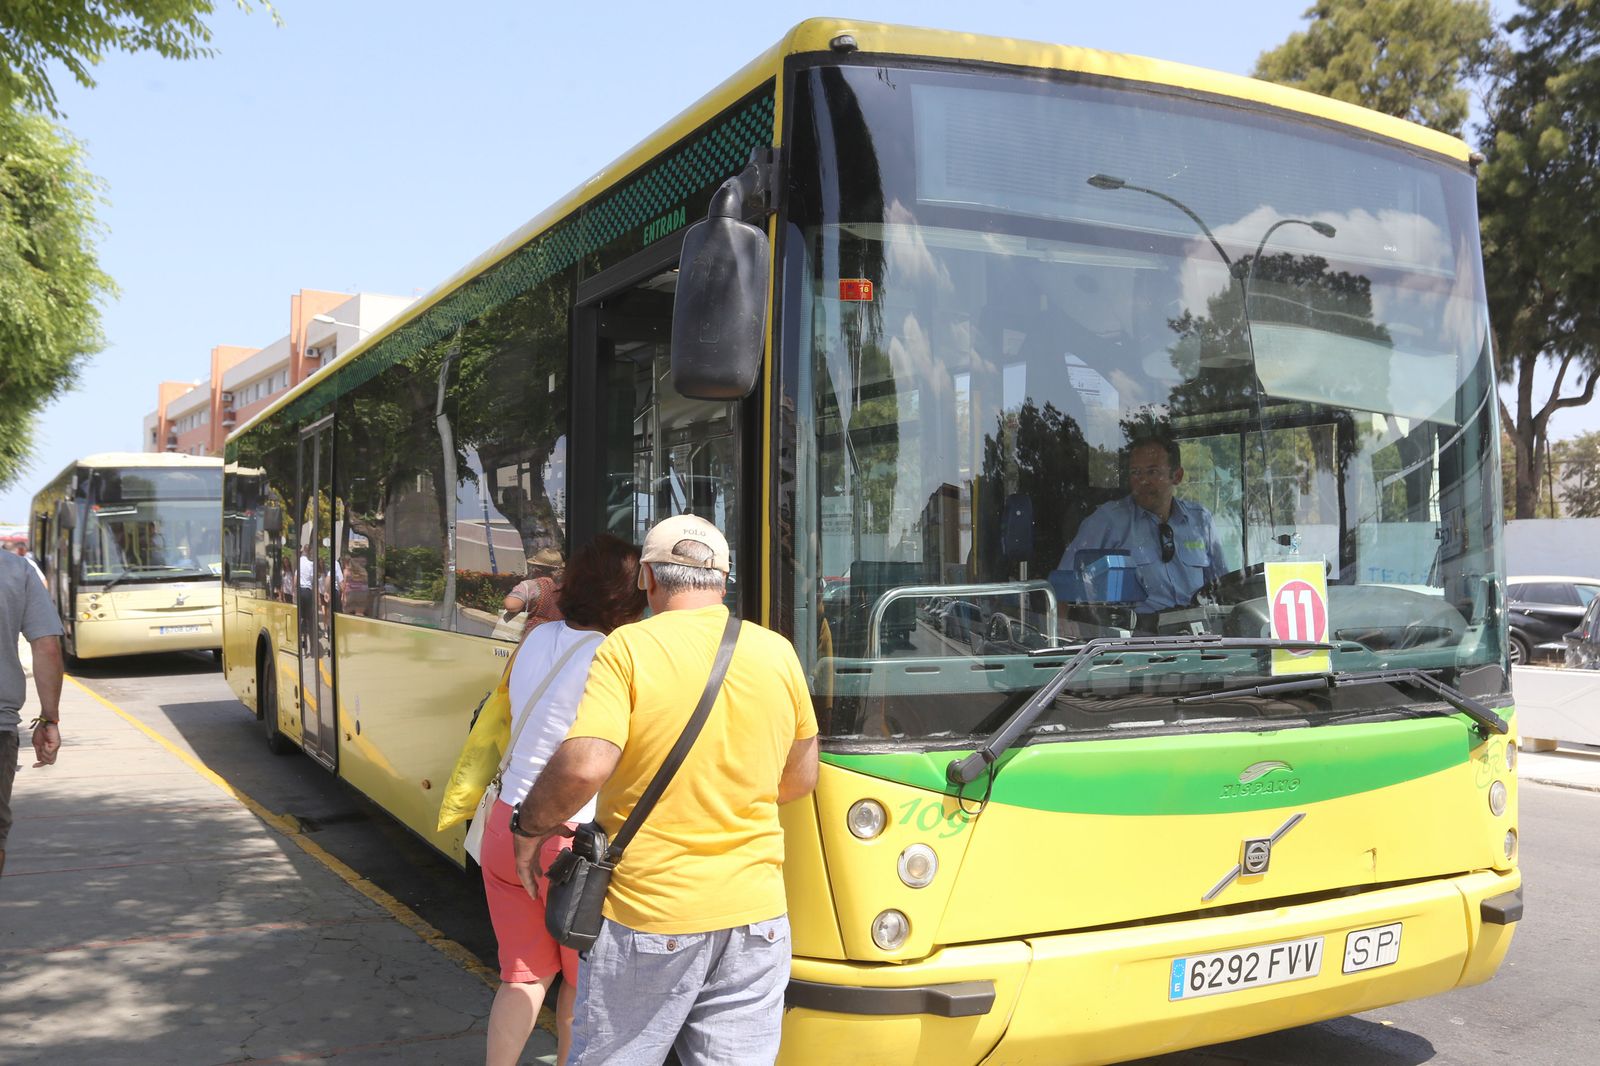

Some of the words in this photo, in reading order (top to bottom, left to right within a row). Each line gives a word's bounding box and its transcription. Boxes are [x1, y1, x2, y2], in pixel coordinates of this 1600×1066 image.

[643, 206, 686, 246] ENTRADA
[683, 528, 706, 537] POLO
[1280, 589, 1316, 641] 11
[1219, 778, 1301, 799] HISPANO
[898, 797, 970, 839] 109
[1174, 982, 1181, 992] E
[1190, 952, 1260, 991] 6292
[1268, 942, 1318, 979] FVV
[1352, 930, 1394, 966] SP
